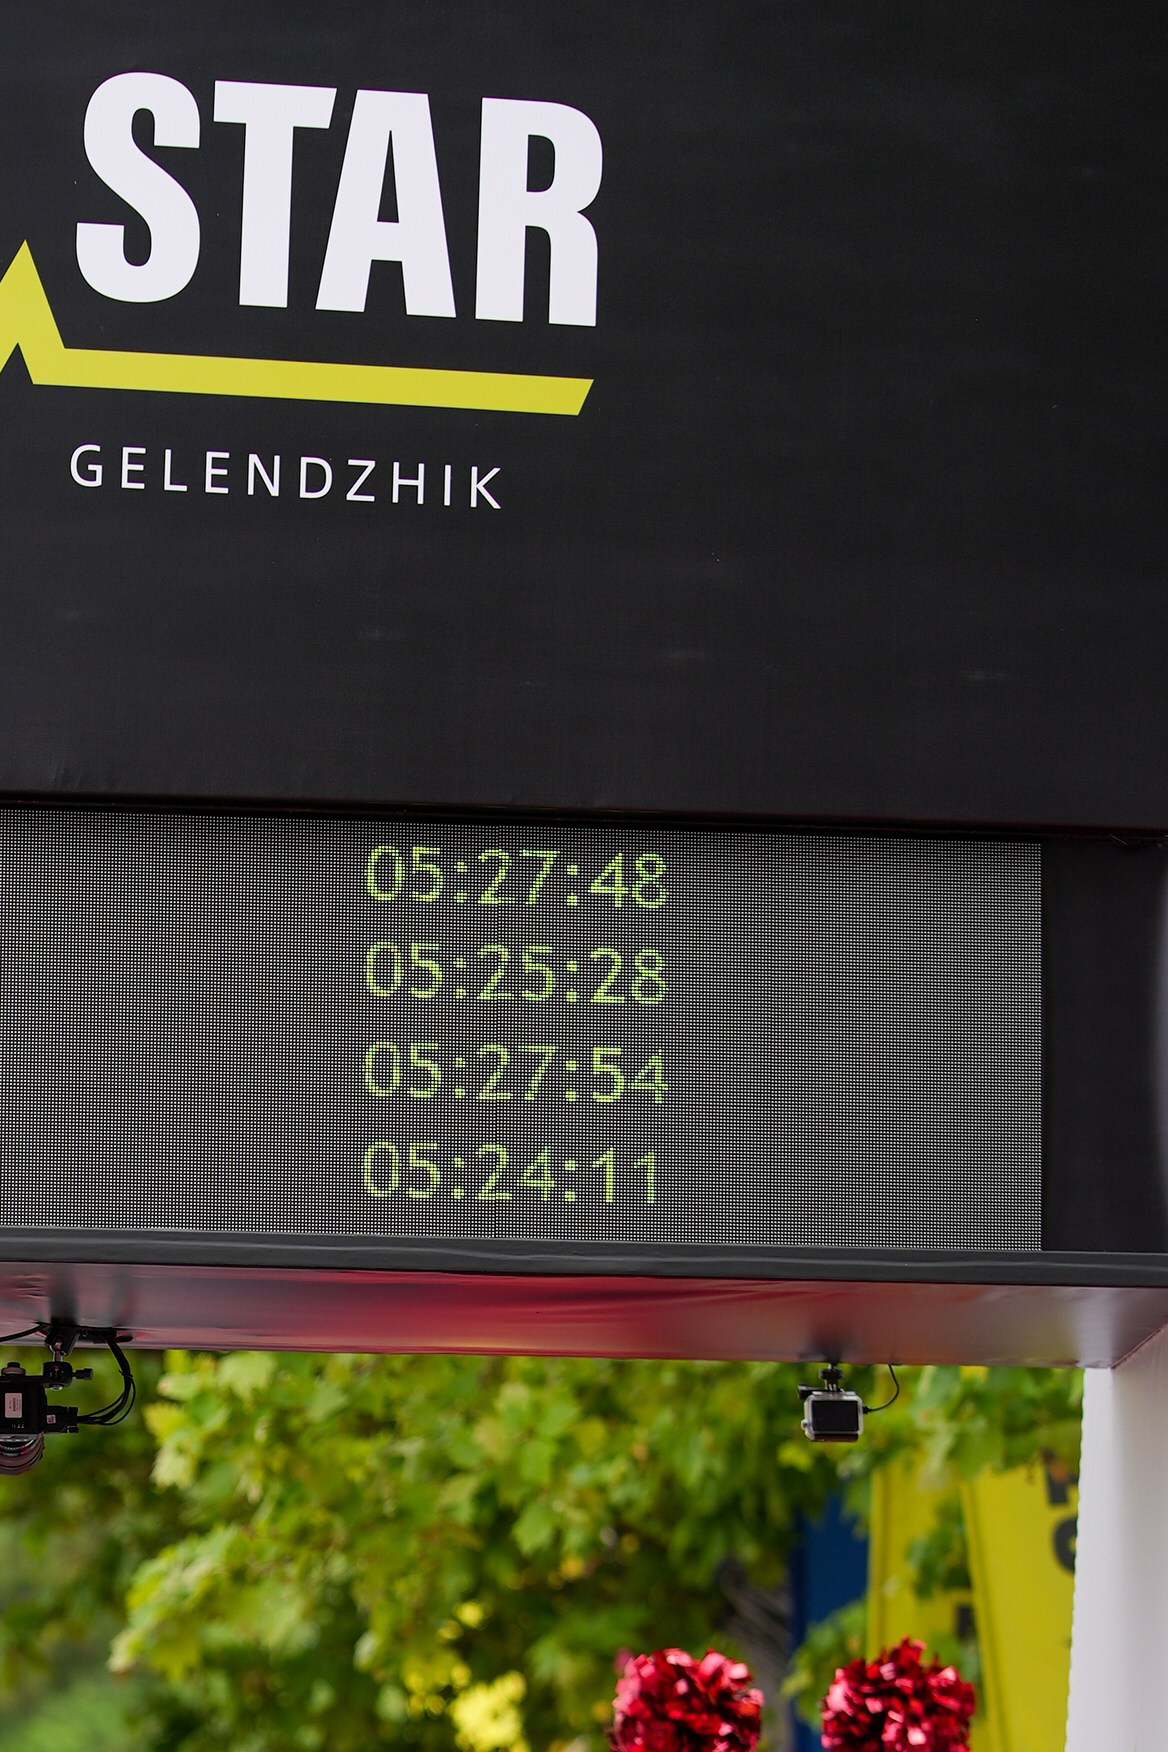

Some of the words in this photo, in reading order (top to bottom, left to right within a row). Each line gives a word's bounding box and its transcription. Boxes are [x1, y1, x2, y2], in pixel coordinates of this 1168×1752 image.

[76, 73, 604, 327] STAR
[70, 444, 502, 509] GELENDZHIK
[364, 843, 668, 910] 05:27:48
[363, 941, 668, 1005] 05:25:28
[361, 1039, 669, 1104] 05:27:54
[361, 1138, 658, 1205] 05:24:11
